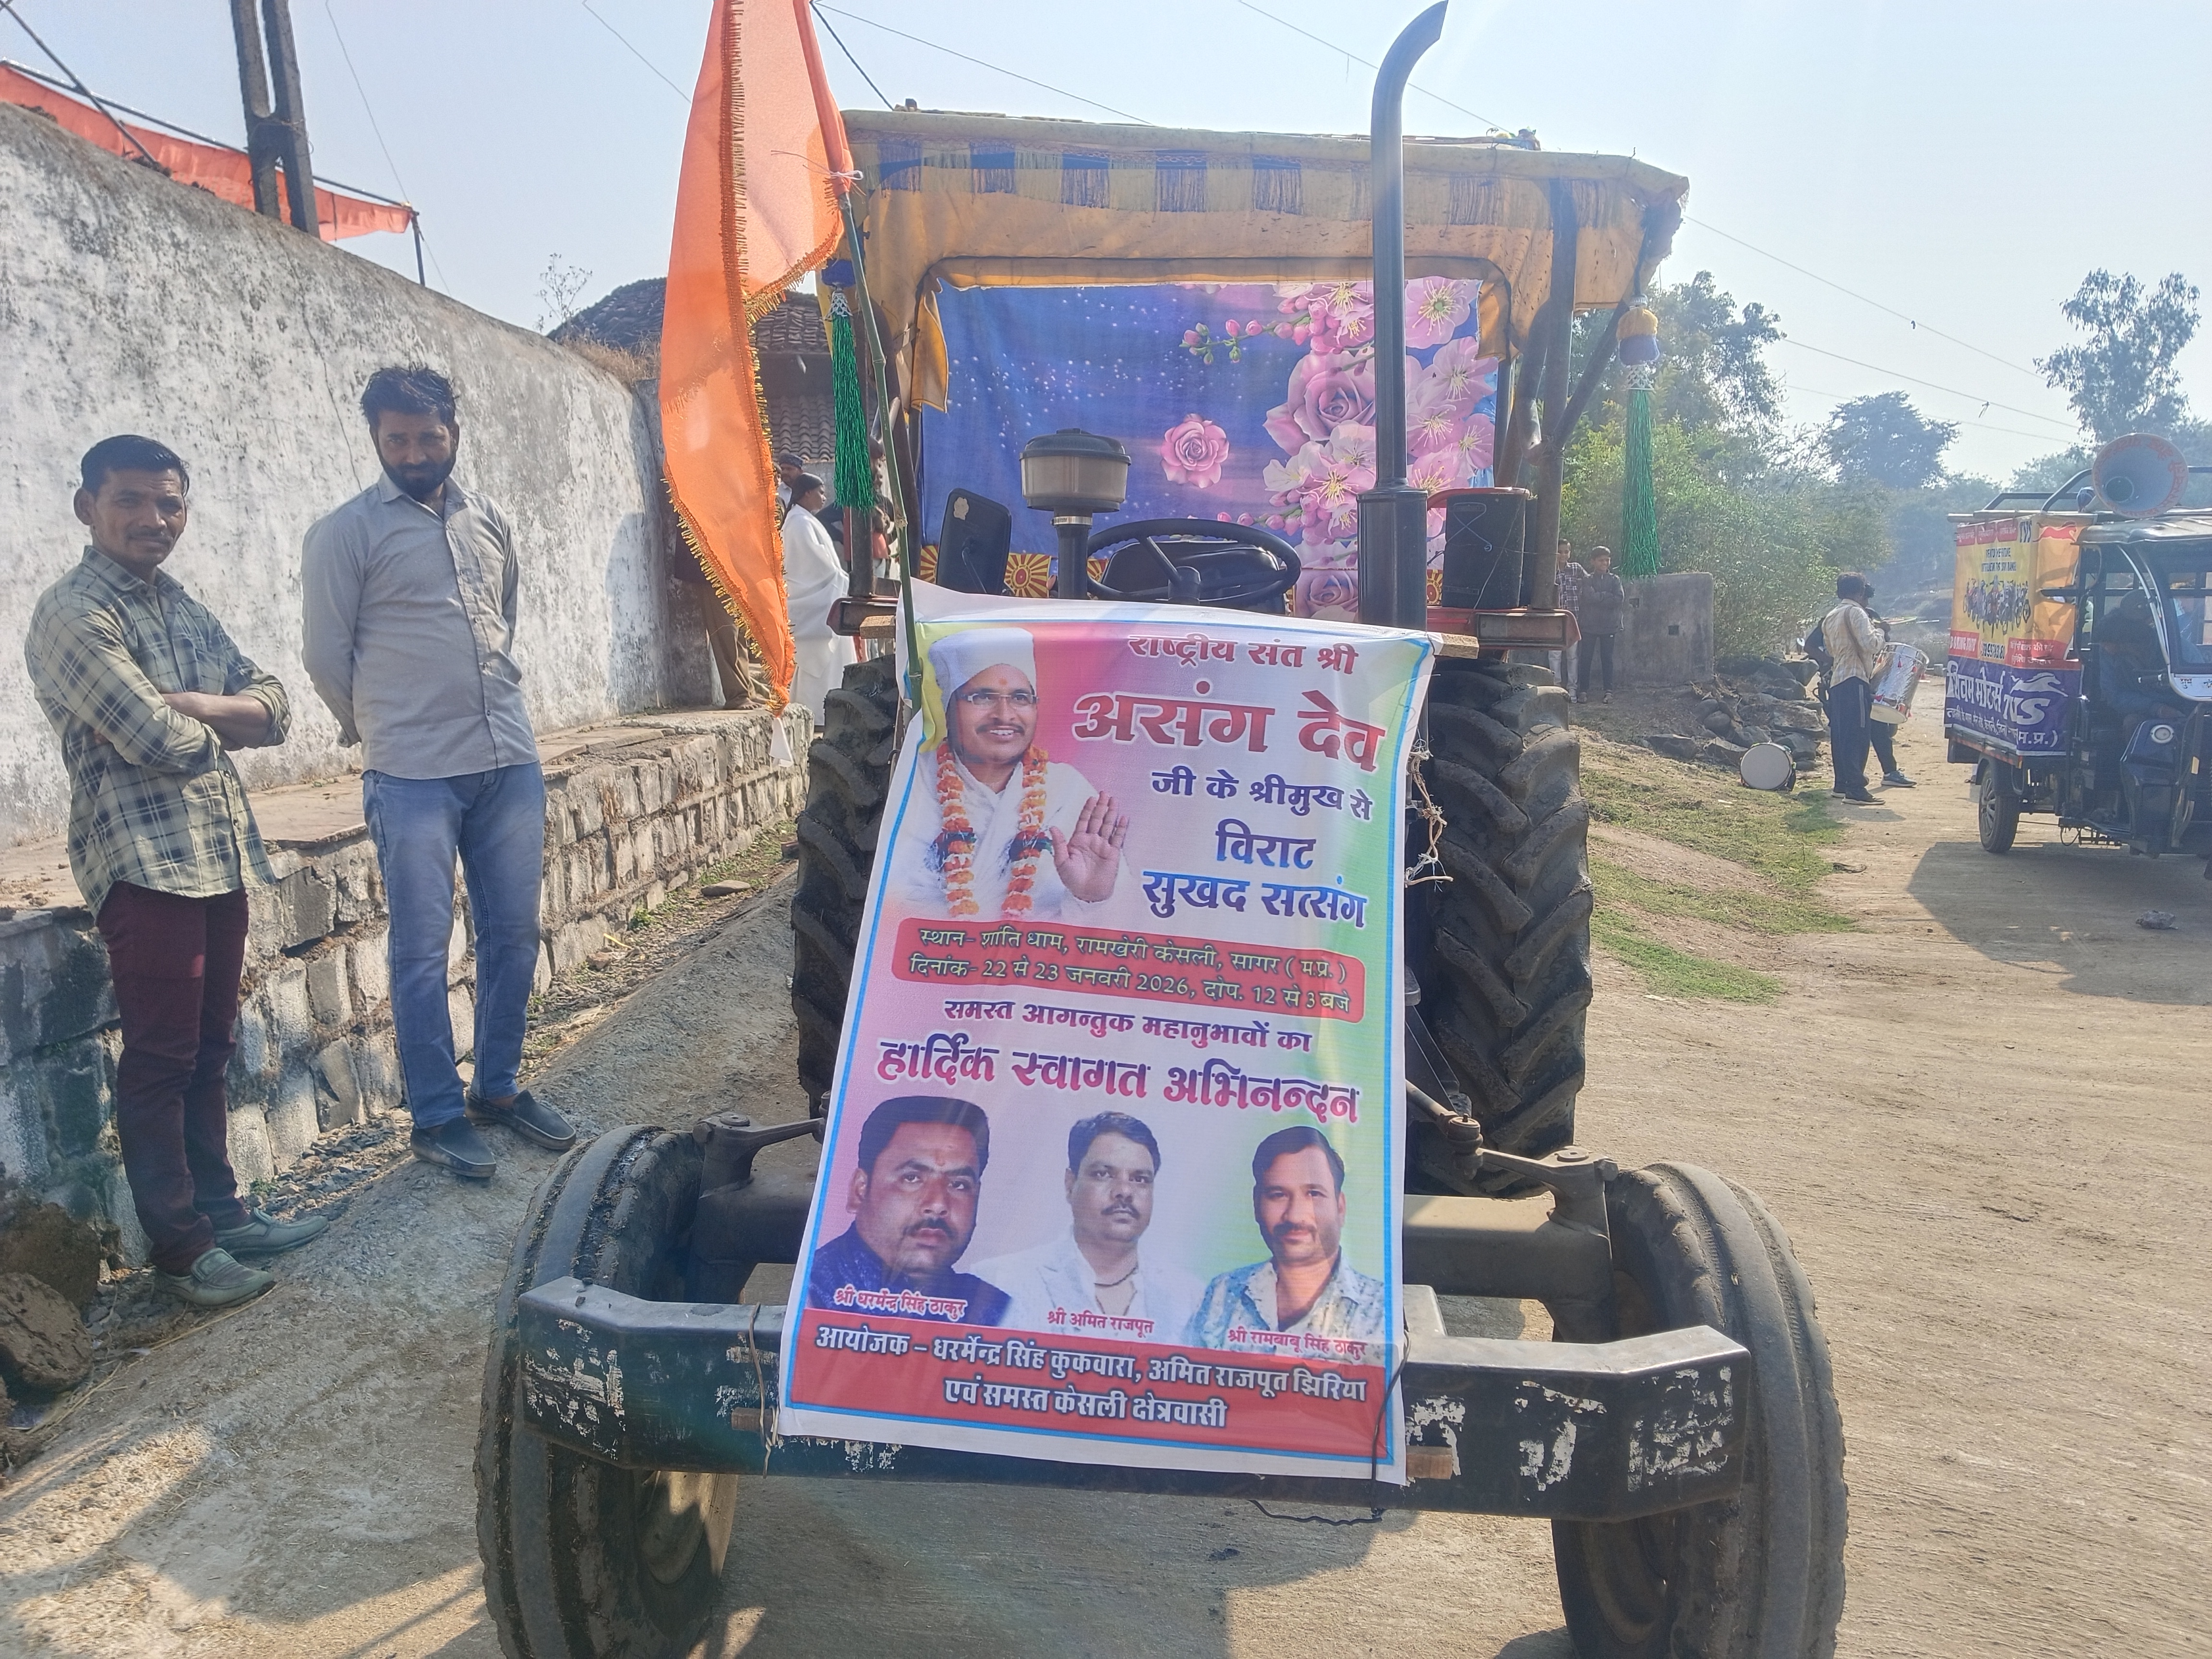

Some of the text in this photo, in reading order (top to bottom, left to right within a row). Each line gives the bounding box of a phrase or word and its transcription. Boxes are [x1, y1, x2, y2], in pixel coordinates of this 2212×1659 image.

[2020, 520, 2032, 543] TVS
[1128, 633, 1359, 674] राष्ट्रीय संत श्री
[1073, 681, 1386, 773] असंग देव
[2003, 694, 2051, 725] TVS
[1152, 765, 1373, 820] जी के श्रीमुख से
[1215, 818, 1316, 869] विराट
[1142, 871, 1367, 928] सुखद सत्संग
[981, 926, 1022, 948] शांति
[1027, 931, 1068, 954] धाम,
[1075, 937, 1149, 959] रामखेरी
[1154, 941, 1222, 970] केसली,
[1230, 952, 1281, 973] सागर
[983, 961, 1007, 977] 22
[1013, 956, 1029, 976] से
[1035, 963, 1058, 980] 23
[1066, 966, 1131, 988] जनवरी
[1137, 974, 1196, 998] 2026,
[1203, 976, 1243, 1000] दोप.
[1253, 987, 1276, 1004] 12
[1283, 986, 1301, 1006] से
[1306, 992, 1315, 1008] 3
[1319, 991, 1350, 1012] बजे
[944, 1001, 1312, 1052] समस्त आगन्तुक महानुभावों का
[877, 1033, 1359, 1123] हार्दिक स्वागत अभिनन्दन
[835, 1285, 855, 1305] श्री
[901, 1291, 926, 1314] सिंह
[929, 1299, 966, 1320] ठाकुर
[1047, 1307, 1154, 1338] श्री अमित राजपूत
[817, 1325, 910, 1355] आयोजक
[1007, 1340, 1047, 1369] सिंह
[1051, 1350, 1142, 1382] कुकवारा,
[1149, 1357, 1212, 1385] अमित
[1215, 1366, 1287, 1397] राजपूत
[1293, 1368, 1366, 1401] झिरिया
[1228, 1325, 1368, 1360] श्री रामबाबू सिंह ठाकुर
[945, 1375, 1226, 1427] एवं समस्त केसली क्षेत्रवासी
